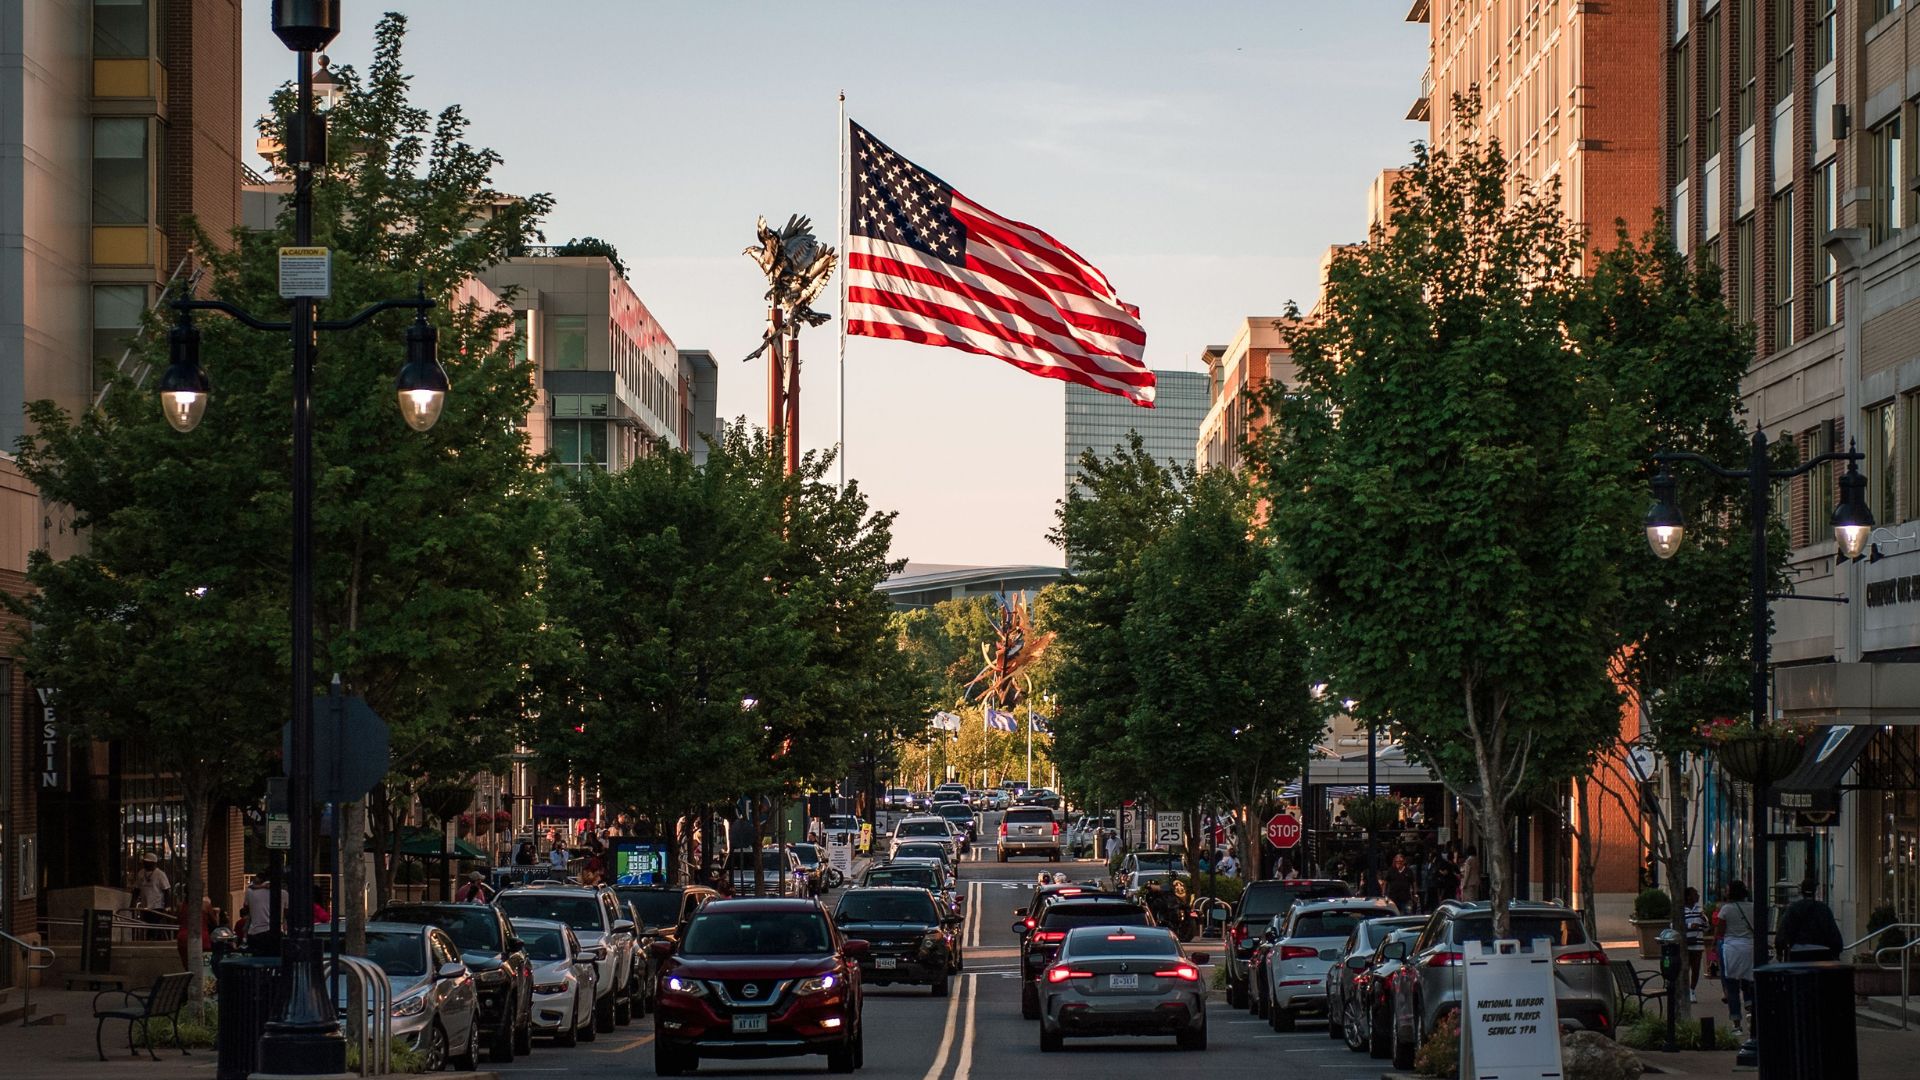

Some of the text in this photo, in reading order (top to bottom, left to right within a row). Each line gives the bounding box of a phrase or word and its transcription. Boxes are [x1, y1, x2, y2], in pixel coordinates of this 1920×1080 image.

[37, 688, 62, 787] WESTIN
[1160, 829, 1180, 841] 25
[1269, 824, 1299, 837] STOP
[1477, 997, 1545, 1009] NATIONAL HARBOR
[1482, 1010, 1541, 1022] REVIVAL PRAYER
[1487, 1025, 1537, 1036] SERVICE 7PM
